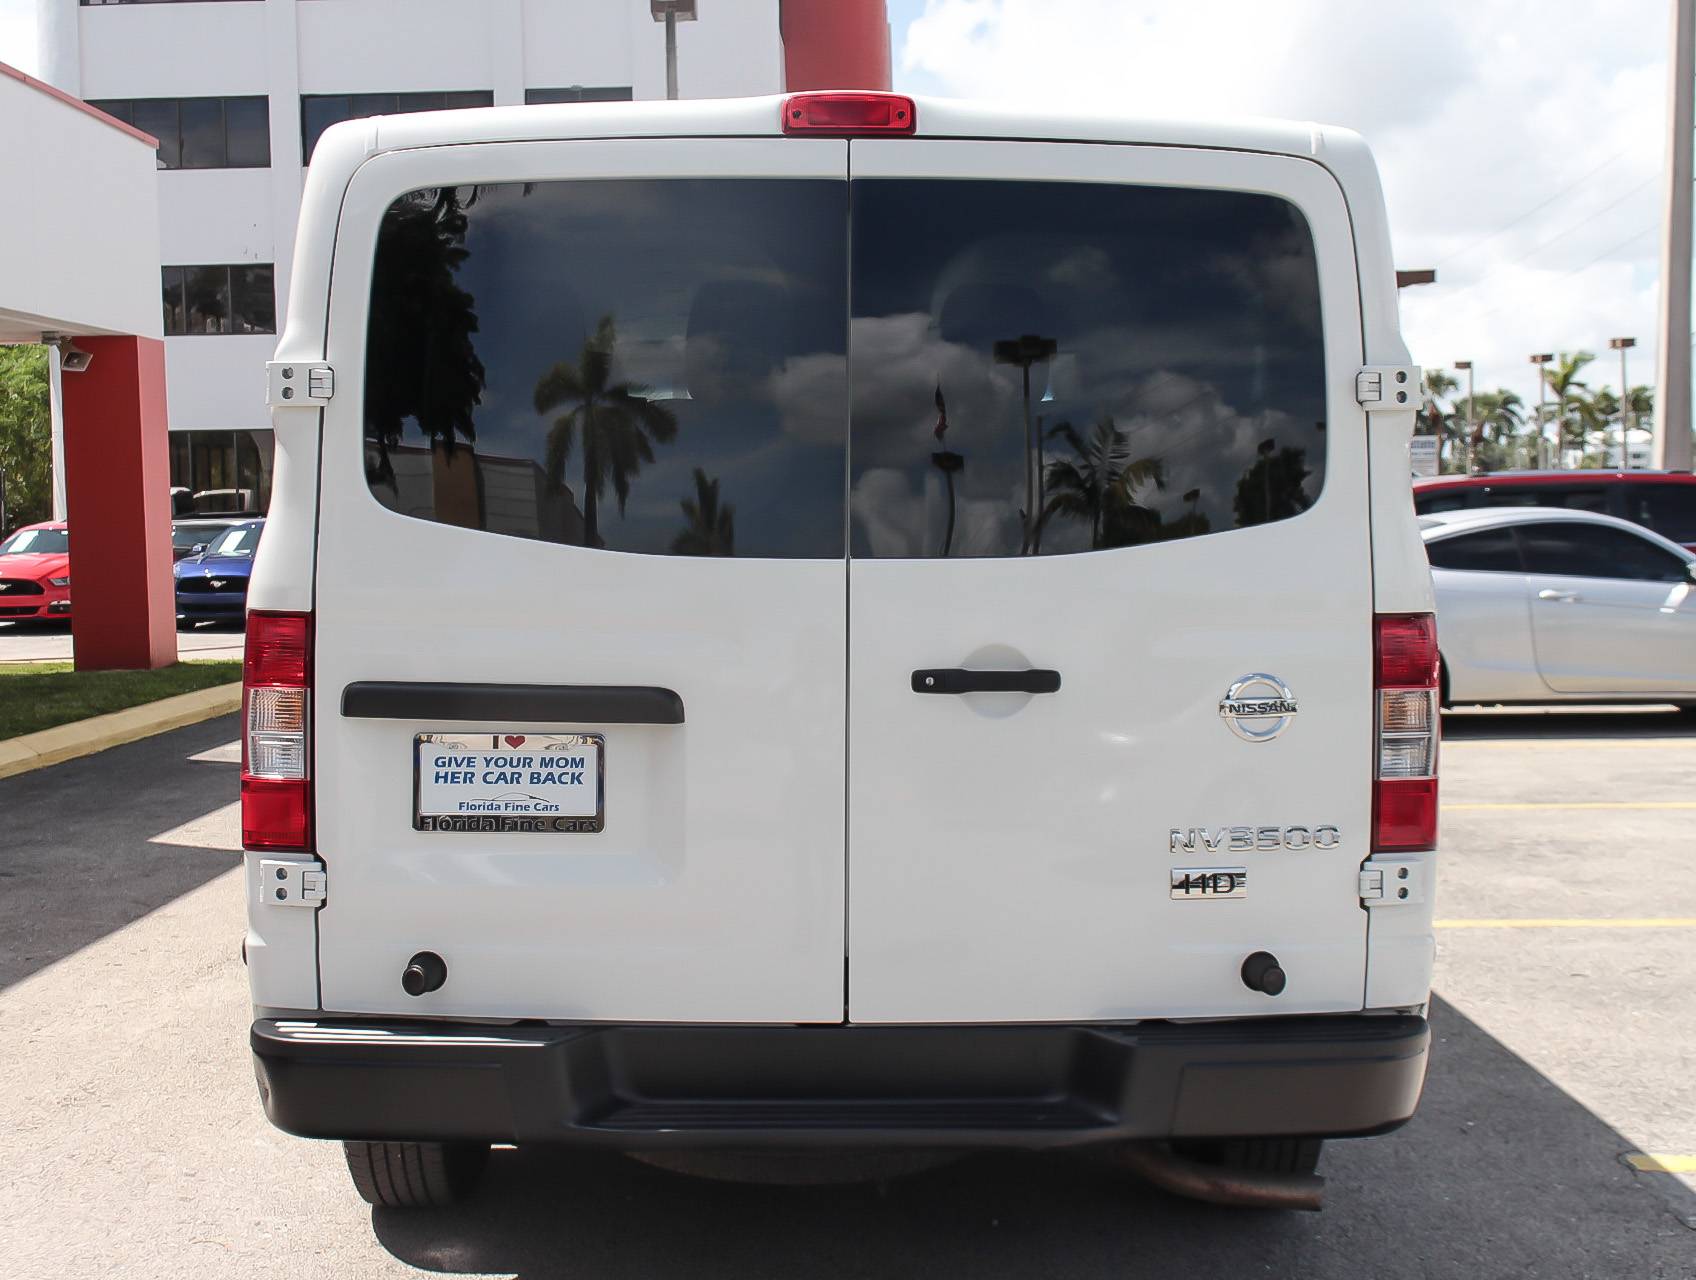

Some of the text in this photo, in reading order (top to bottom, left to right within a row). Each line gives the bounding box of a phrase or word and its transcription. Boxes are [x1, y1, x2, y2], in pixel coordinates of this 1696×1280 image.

[1228, 702, 1295, 714] NISSAN
[434, 756, 585, 768] GIVE YOUR MOM
[434, 772, 584, 785] HER CAR BACK
[459, 802, 560, 811] Florida Fine Cars
[420, 816, 597, 831] Florida Fine Cars
[1170, 825, 1341, 853] NV3500
[1184, 873, 1235, 894] HD
